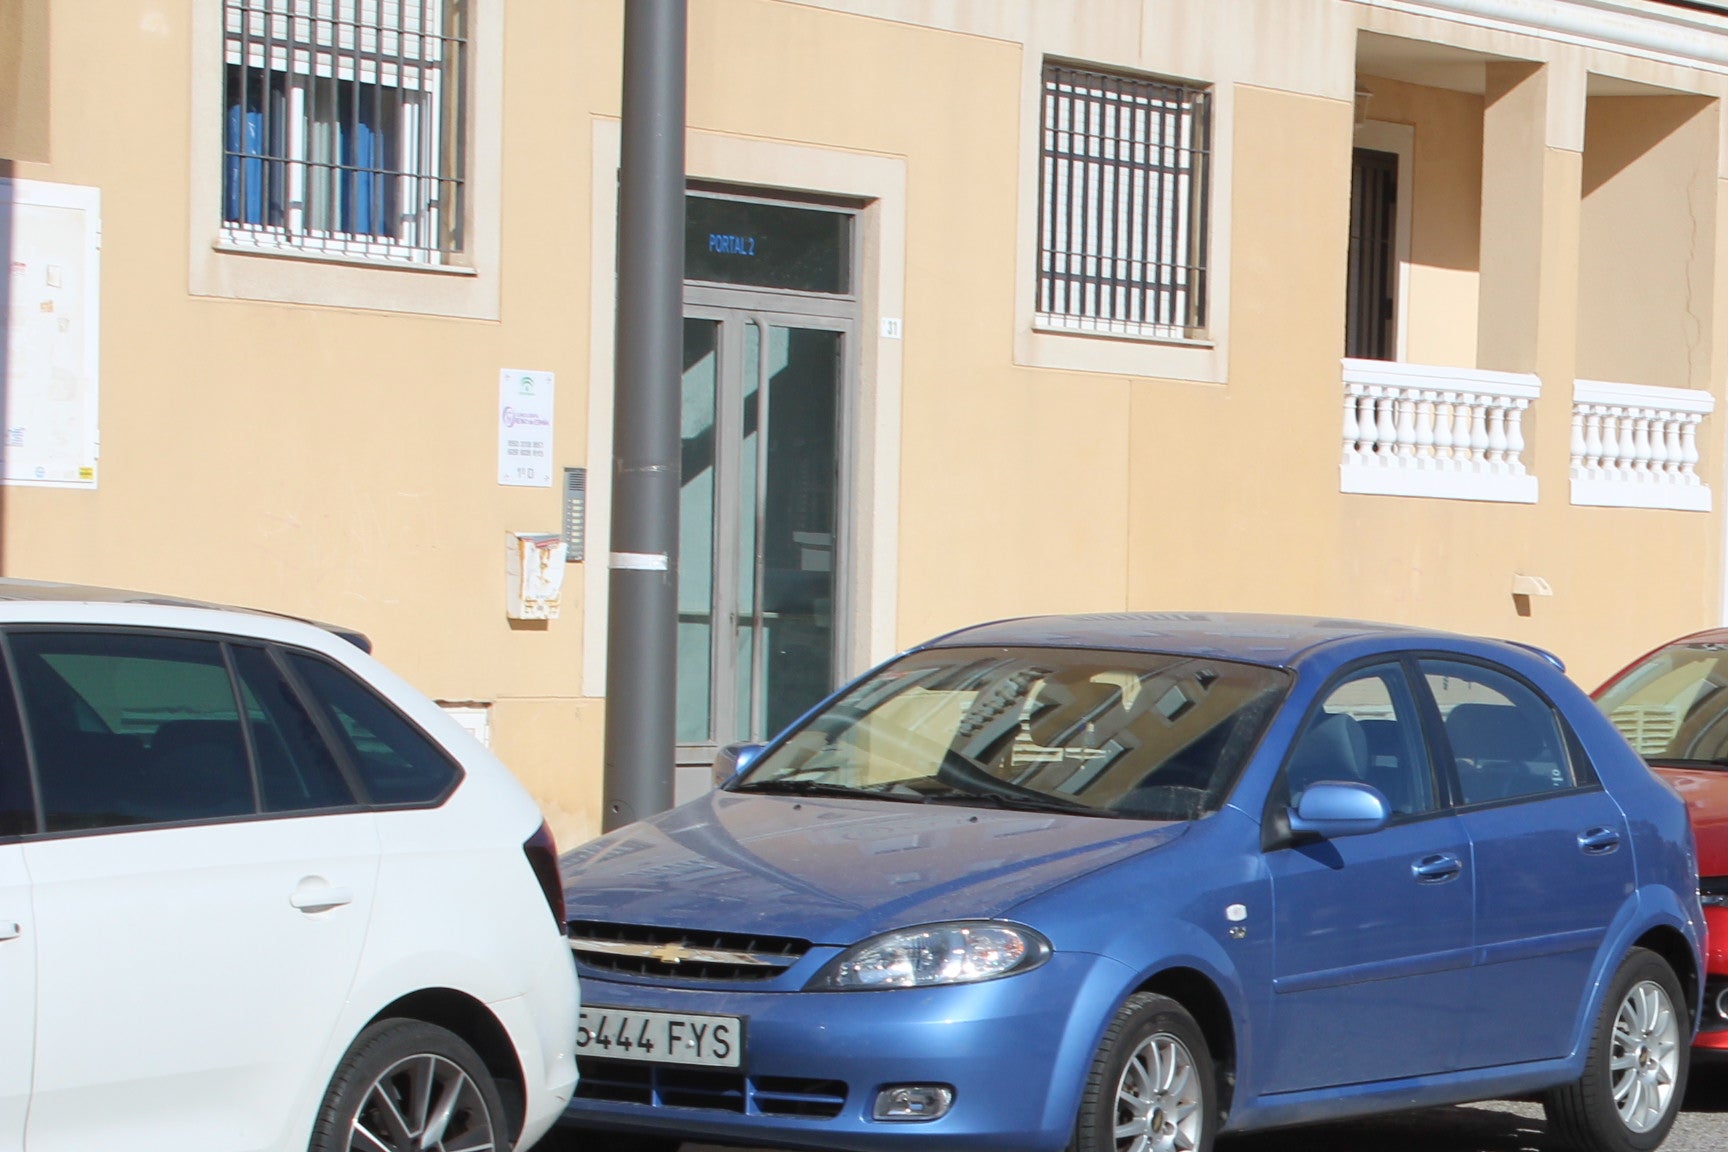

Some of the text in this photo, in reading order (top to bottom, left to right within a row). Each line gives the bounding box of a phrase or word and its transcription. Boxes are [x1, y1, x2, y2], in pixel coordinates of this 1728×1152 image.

[709, 234, 755, 256] PORTAL 2
[668, 1021, 730, 1059] FYS
